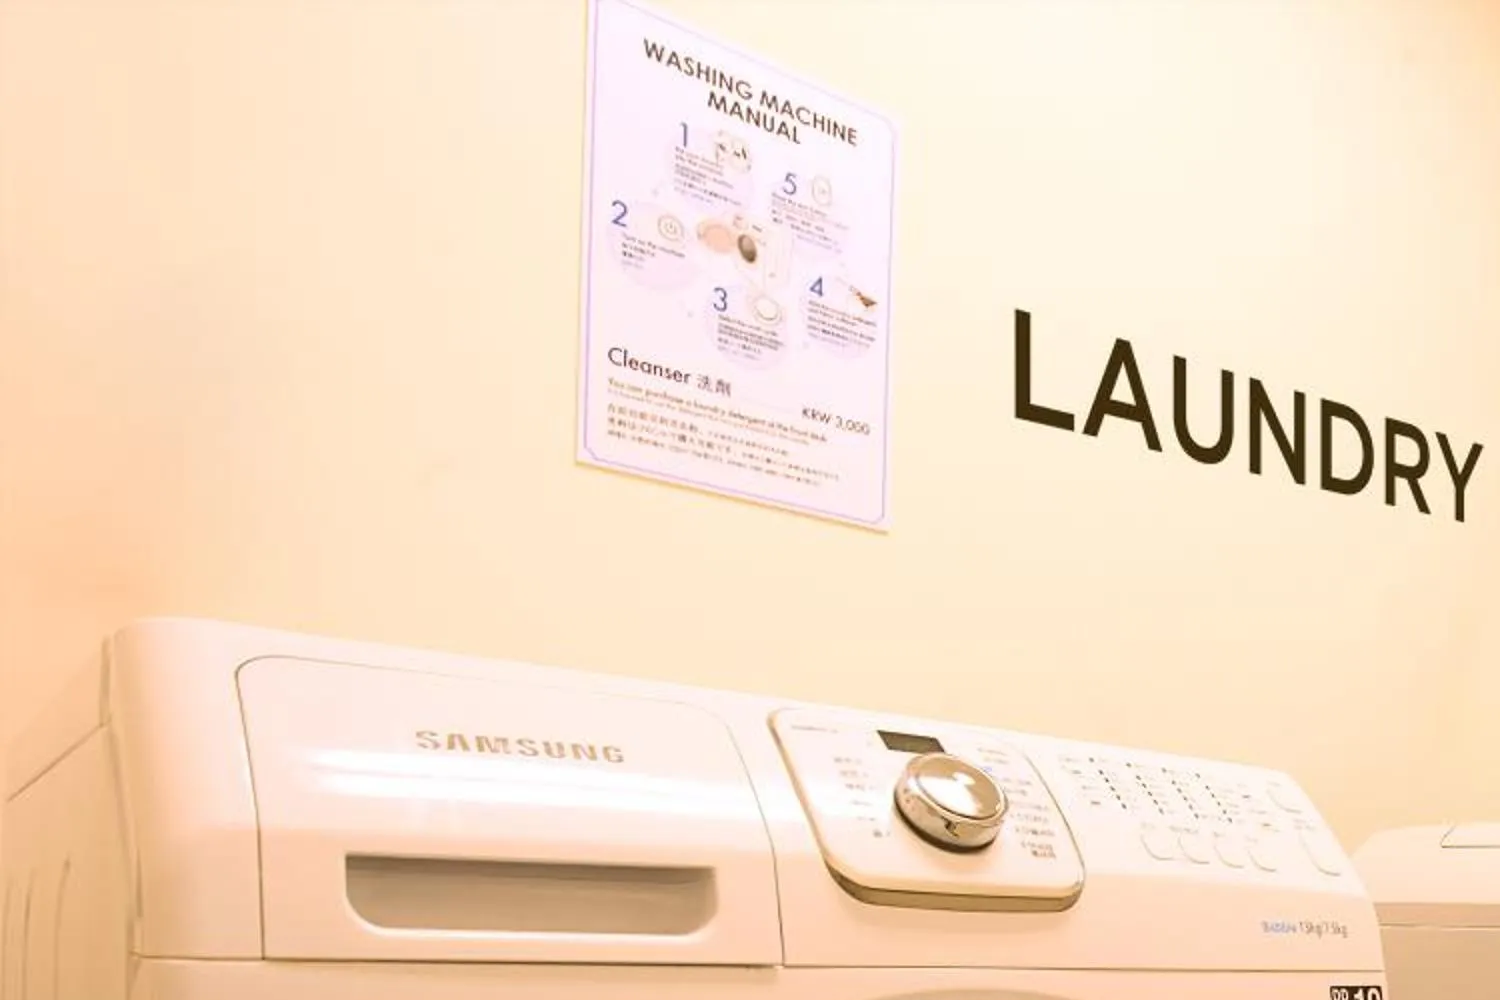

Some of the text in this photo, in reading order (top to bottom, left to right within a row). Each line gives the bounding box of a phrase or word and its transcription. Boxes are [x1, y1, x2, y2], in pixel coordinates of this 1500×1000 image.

[643, 37, 858, 147] WASHING MACHINE
[707, 91, 801, 145] MANUAL
[680, 122, 688, 148] 1
[782, 171, 797, 196] 5
[611, 200, 629, 227] 2
[713, 287, 728, 312] 3
[809, 276, 824, 297] 4
[607, 347, 692, 385] Cleanser
[802, 407, 871, 436] KRW 3,000
[1014, 308, 1484, 523] LAUNDRY
[415, 730, 625, 764] SAMSUNG
